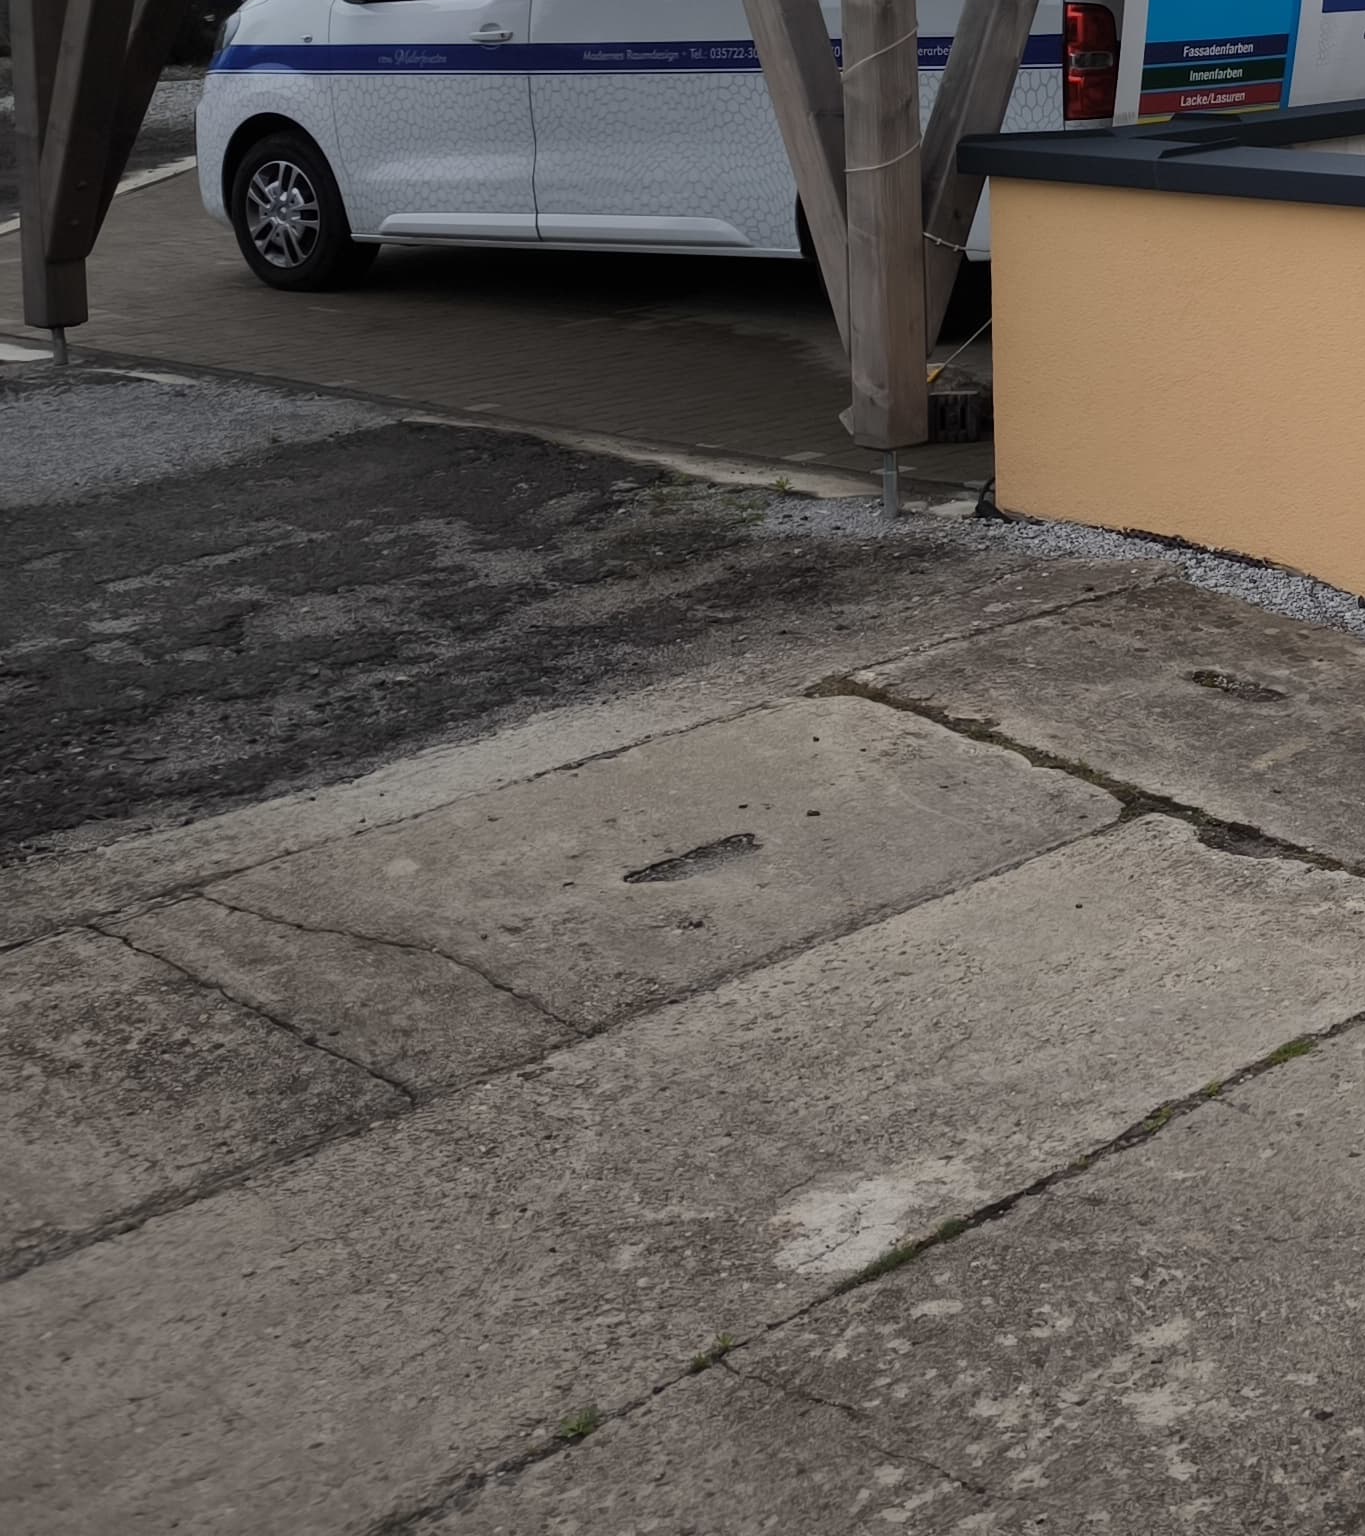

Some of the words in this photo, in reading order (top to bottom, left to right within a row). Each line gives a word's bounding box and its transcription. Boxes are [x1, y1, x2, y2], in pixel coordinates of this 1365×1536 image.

[710, 47, 758, 60] 035722-30
[1183, 42, 1254, 58] Fassadenfarben
[1190, 67, 1243, 82] Innenfarben
[1180, 92, 1245, 107] Lacke/Lasuren
